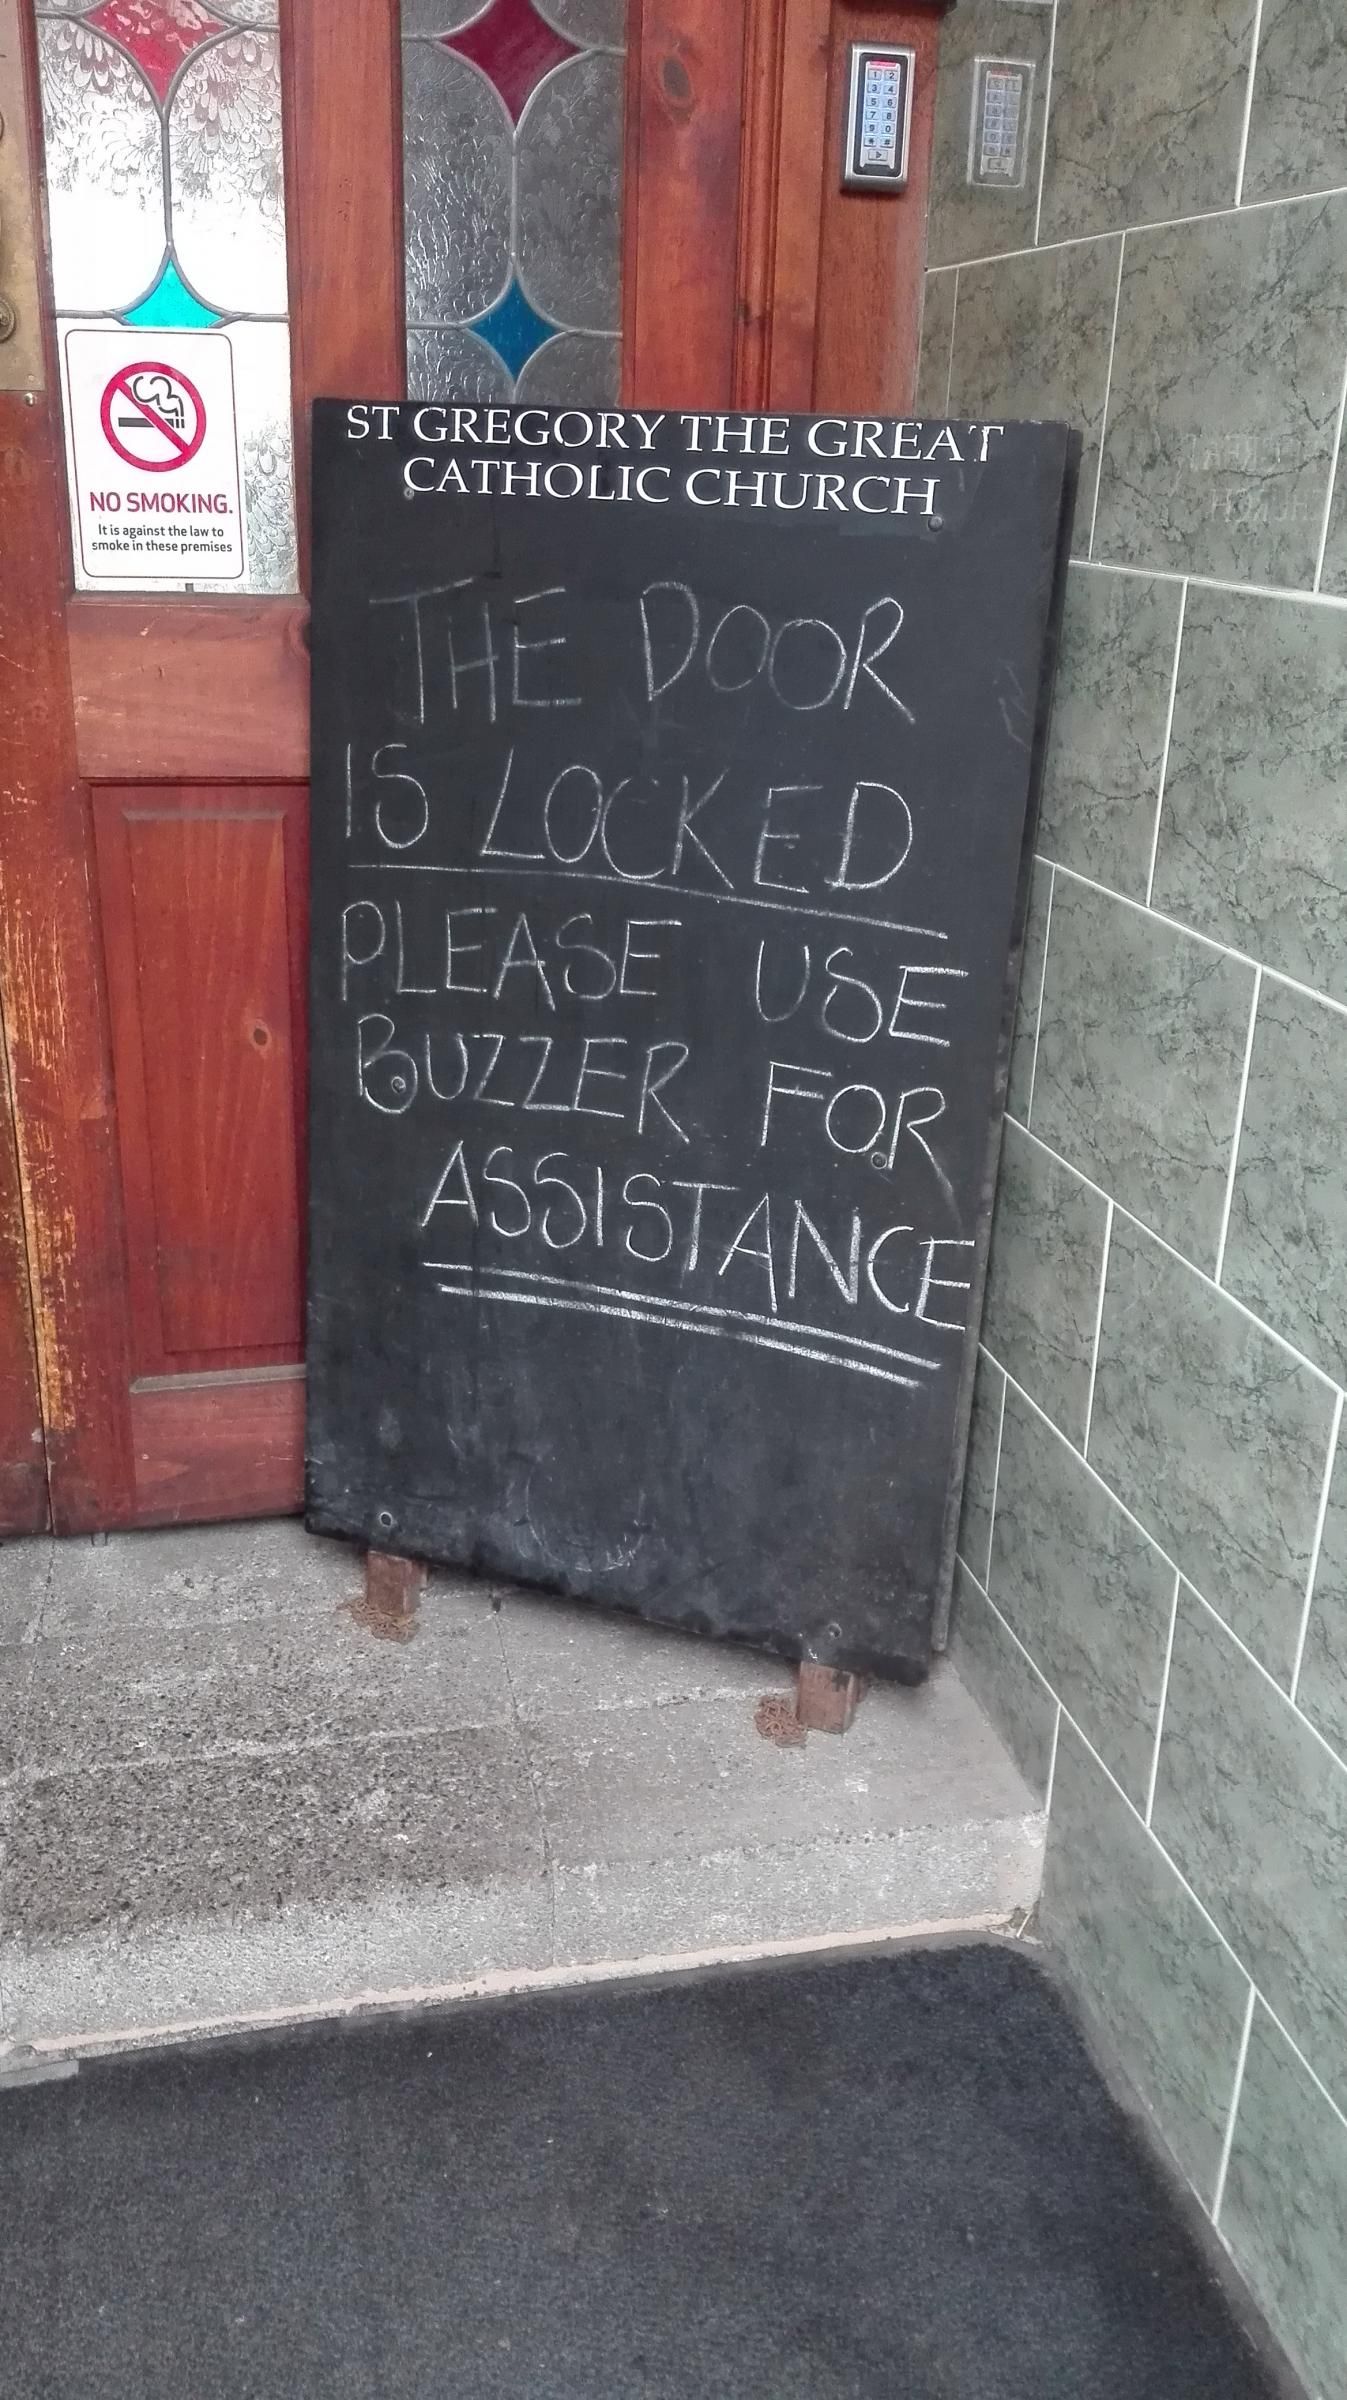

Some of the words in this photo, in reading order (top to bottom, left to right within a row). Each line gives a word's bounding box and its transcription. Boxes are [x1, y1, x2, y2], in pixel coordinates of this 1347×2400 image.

[347, 405, 400, 440] ST
[413, 407, 665, 450] GREGORY
[680, 415, 790, 455] THE
[807, 419, 1004, 462] GREAT
[90, 491, 121, 512] NO
[126, 492, 233, 514] SMOKING.
[98, 523, 107, 535] It
[110, 524, 120, 536] is
[122, 525, 165, 539] against
[168, 525, 187, 537] the
[190, 525, 209, 537] law
[211, 527, 224, 537] to
[403, 457, 671, 503] CATHOLIC
[685, 468, 941, 515] CHURCH
[92, 539, 130, 551] smoke
[132, 540, 143, 551] in
[146, 540, 178, 552] these
[181, 541, 233, 555] premises
[369, 576, 582, 724] THE
[640, 580, 916, 724] DOOR
[345, 743, 429, 850] IS
[480, 747, 913, 893] LOCKED
[342, 900, 682, 1010] PLEASE
[756, 940, 969, 1046] USE
[357, 1014, 690, 1143] BUZZER
[760, 1061, 955, 1195] FOR
[421, 1140, 976, 1331] ASSISTANCE
